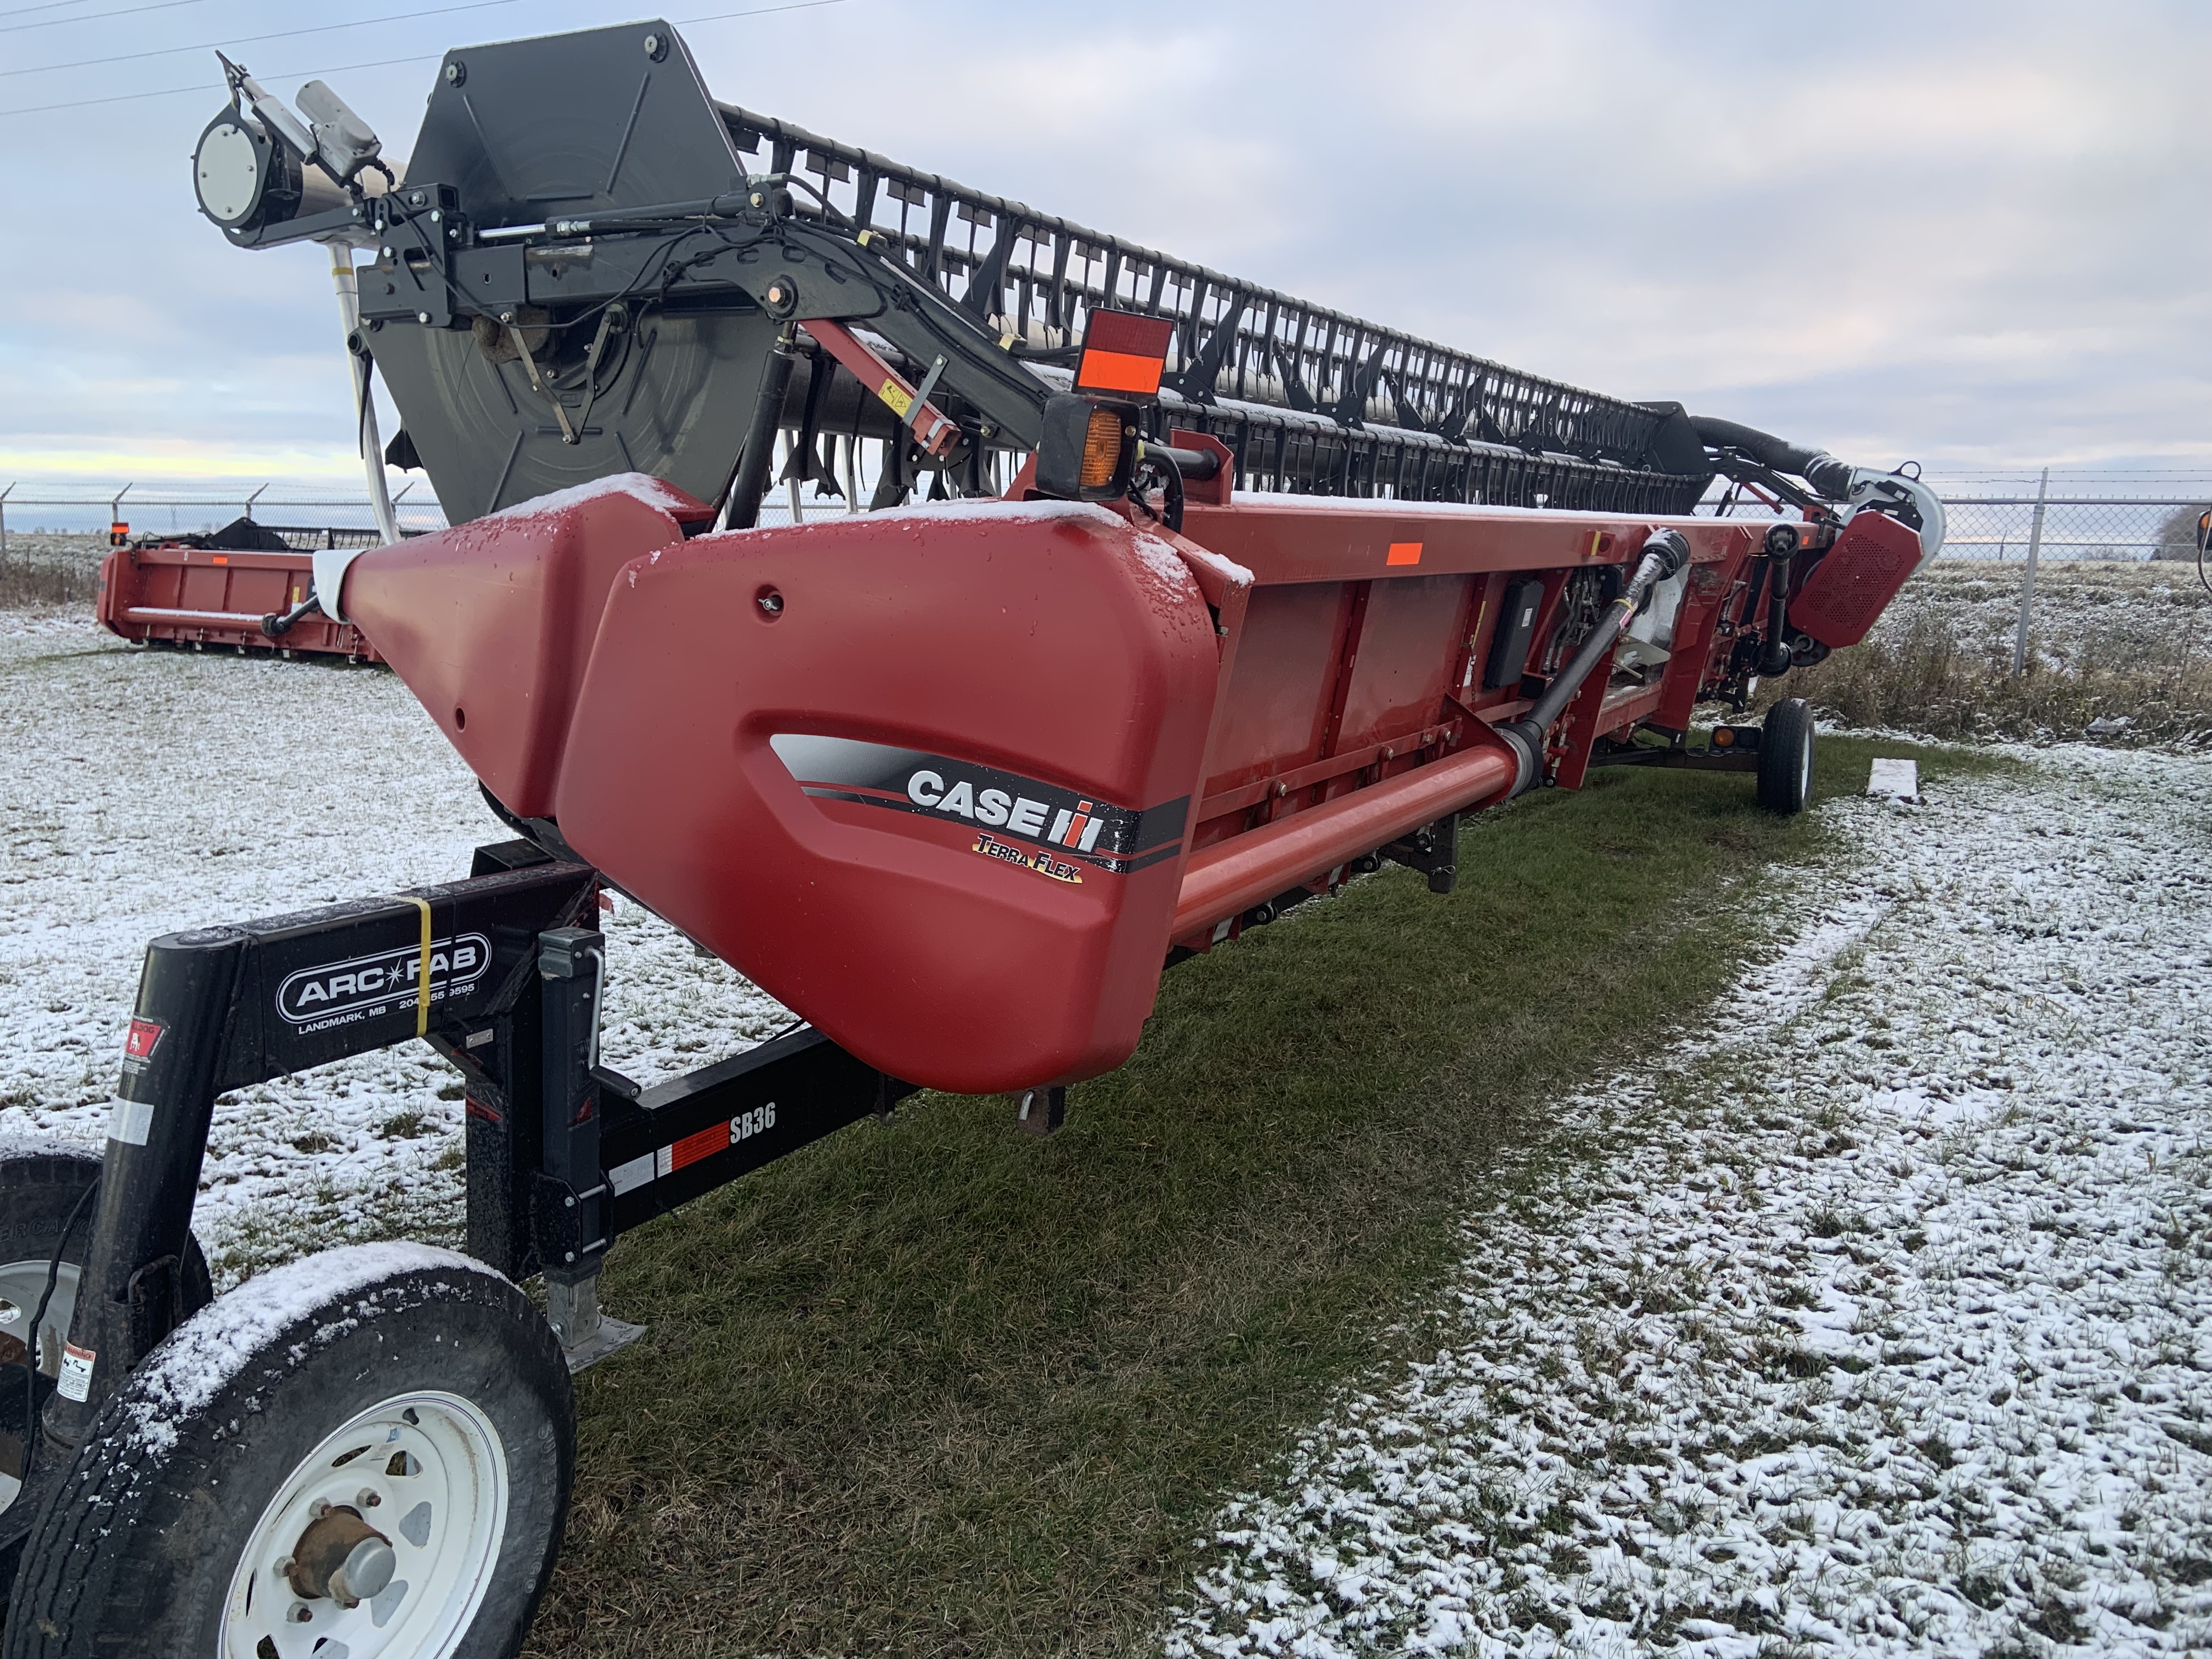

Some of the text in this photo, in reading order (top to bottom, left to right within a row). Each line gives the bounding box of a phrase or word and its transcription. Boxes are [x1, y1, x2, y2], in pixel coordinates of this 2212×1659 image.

[908, 770, 1050, 838] CASE
[977, 833, 1081, 882] TERRA FLEX
[296, 946, 476, 1007] ARC FAB
[298, 1011, 365, 1035] LANDMARK,
[369, 1006, 387, 1017] MB
[730, 1102, 776, 1144] SB36
